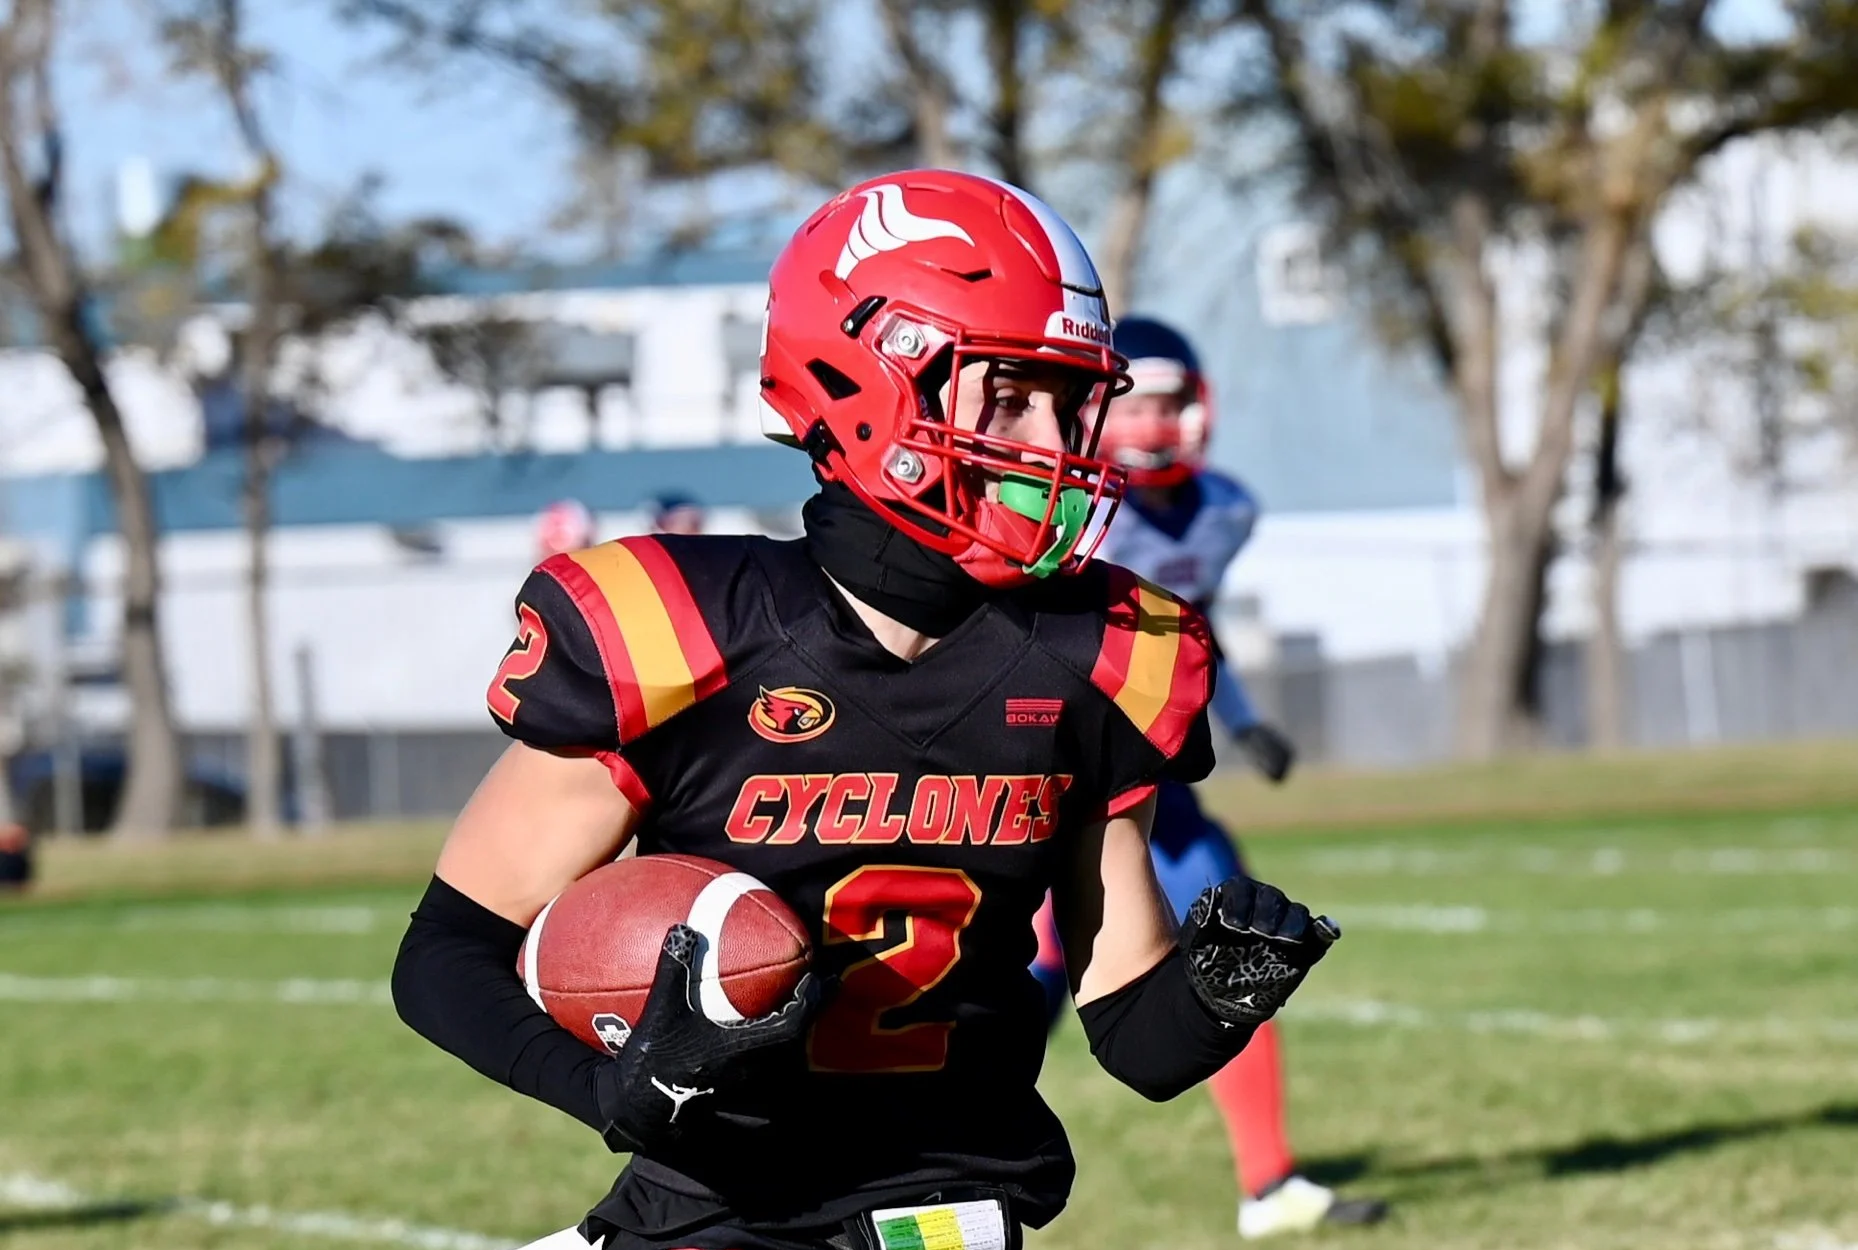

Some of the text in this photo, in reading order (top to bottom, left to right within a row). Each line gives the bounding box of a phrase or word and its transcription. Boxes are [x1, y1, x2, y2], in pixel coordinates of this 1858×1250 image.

[486, 602, 548, 726] 2
[724, 772, 1073, 846] CYCLONES
[806, 864, 982, 1073] 2
